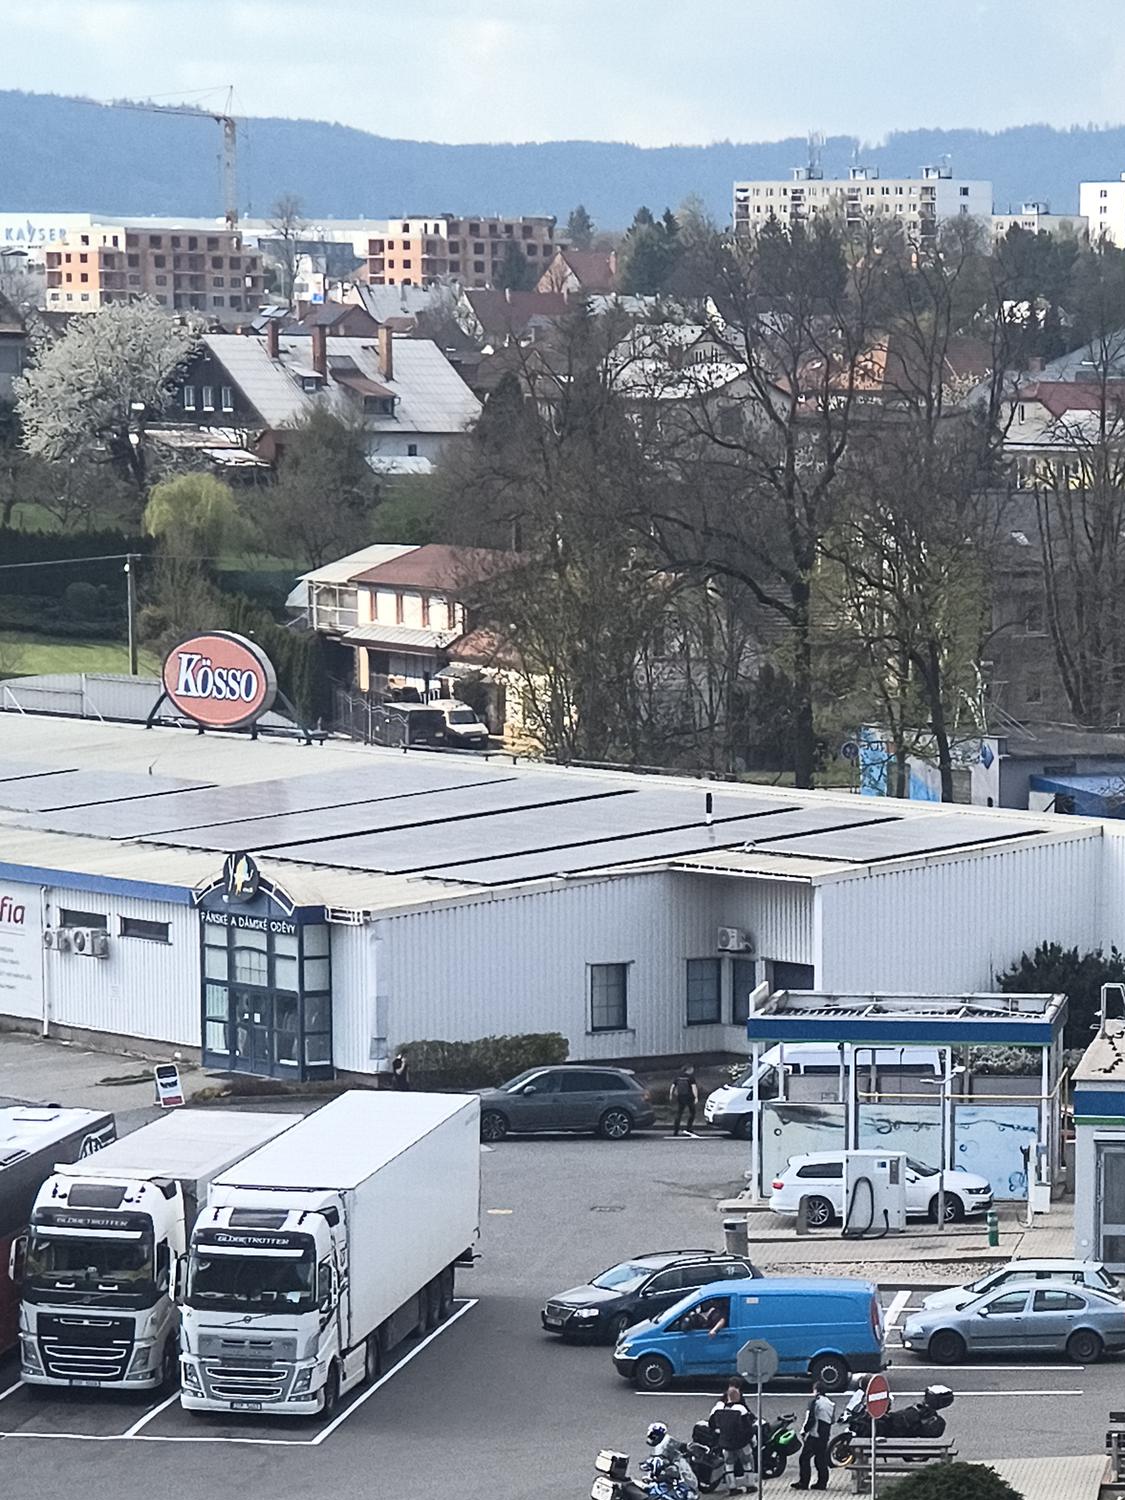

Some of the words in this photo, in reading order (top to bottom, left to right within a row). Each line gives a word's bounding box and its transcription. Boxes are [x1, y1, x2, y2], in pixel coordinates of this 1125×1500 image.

[5, 220, 66, 242] KAYSER
[201, 911, 228, 925] PÁNSKÉ
[230, 916, 237, 926] A
[239, 916, 268, 931] DÁMSKÉ
